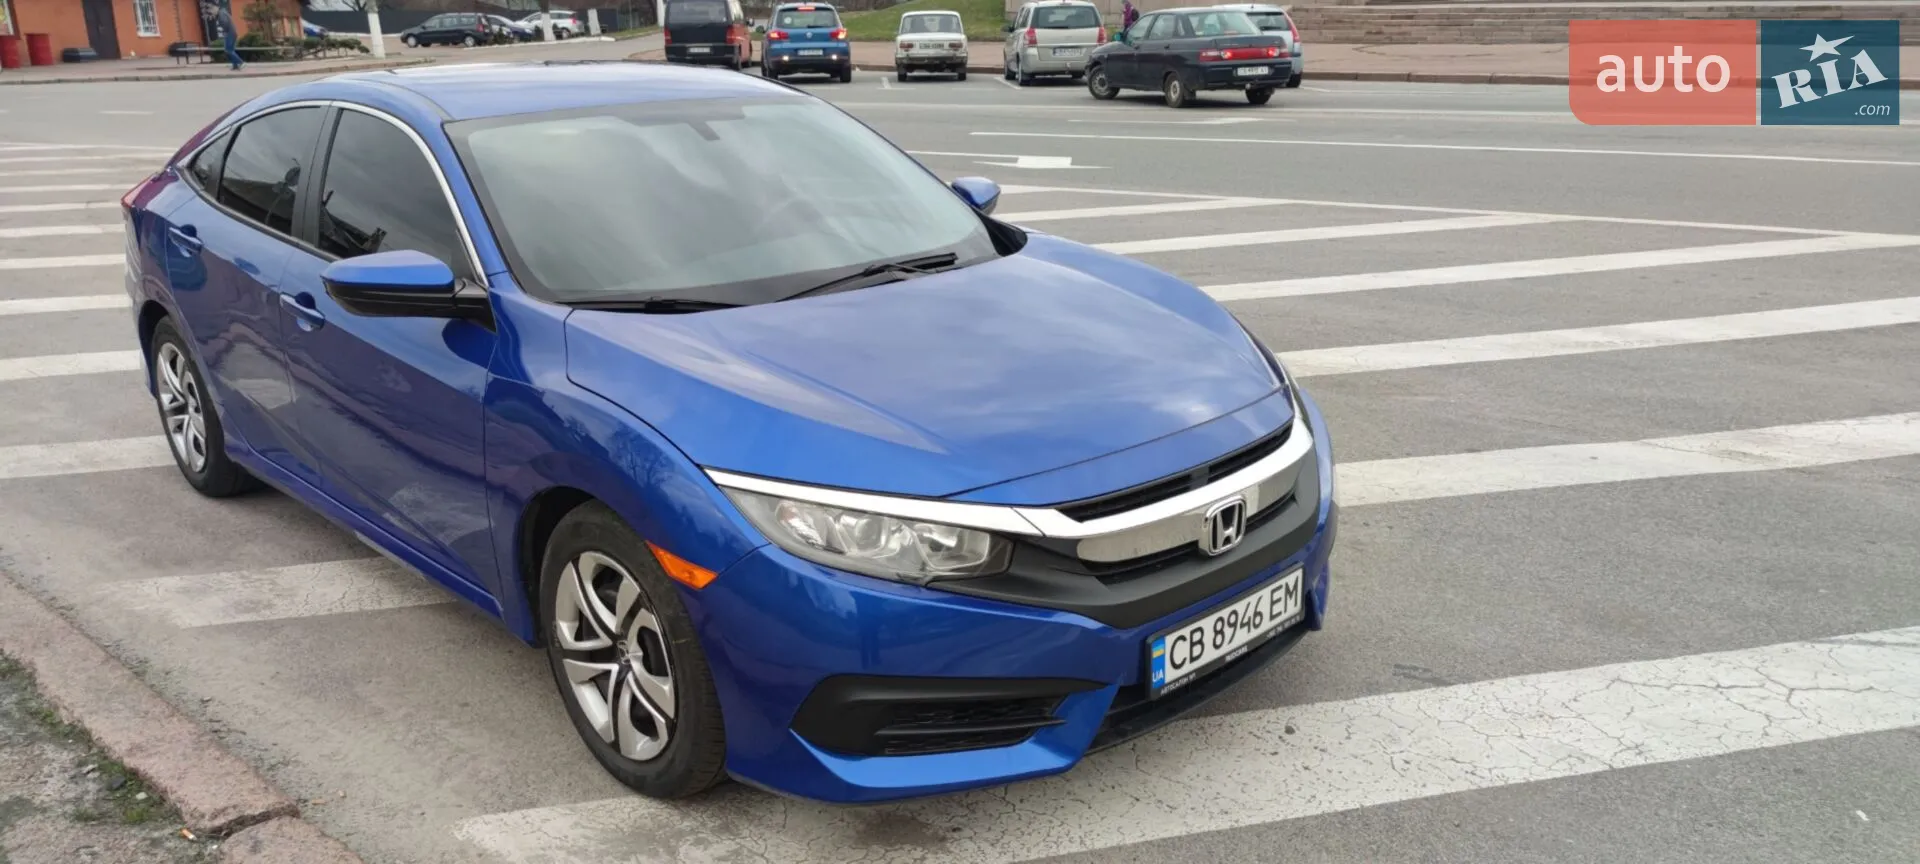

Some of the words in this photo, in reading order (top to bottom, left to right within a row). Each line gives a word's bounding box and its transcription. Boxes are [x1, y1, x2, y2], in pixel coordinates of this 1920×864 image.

[1169, 626, 1205, 670] CB
[1212, 595, 1264, 650] 8946
[1269, 576, 1299, 621] EM
[1152, 672, 1164, 683] UA
